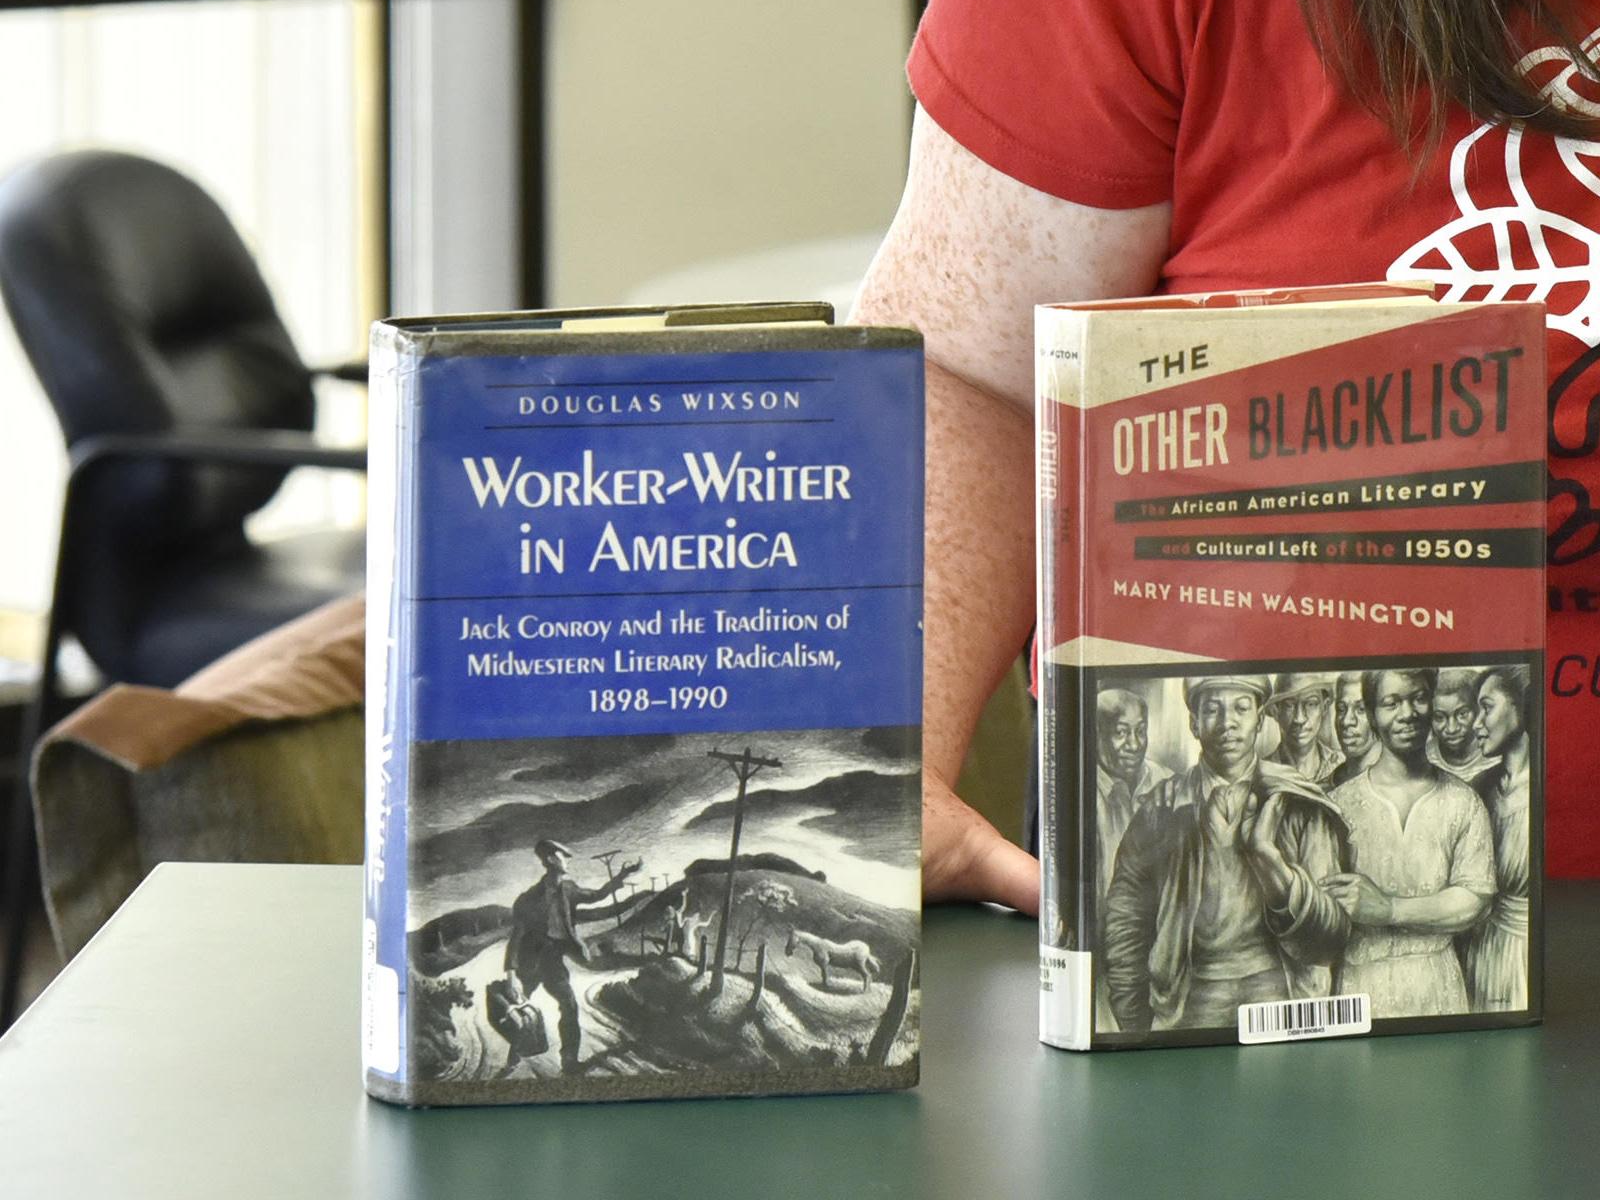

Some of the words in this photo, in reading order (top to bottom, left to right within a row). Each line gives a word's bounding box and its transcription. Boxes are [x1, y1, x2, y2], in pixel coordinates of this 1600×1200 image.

[1140, 344, 1209, 384] THE
[519, 393, 662, 415] DOUGLAS
[683, 391, 800, 411] WIXSON
[1113, 403, 1229, 475] OTHER
[1248, 347, 1524, 461] BLACKLIST
[1141, 503, 1168, 518] The
[1171, 498, 1238, 516] African
[1247, 489, 1349, 512] American
[1360, 479, 1486, 503] Literary
[520, 523, 564, 574] in
[1161, 541, 1190, 555] and
[1196, 539, 1274, 557] Cultural
[1280, 540, 1317, 557] Left
[1326, 540, 1349, 557] of
[1355, 540, 1395, 557] the
[1405, 539, 1491, 559] 1950s
[459, 616, 510, 641] Jack
[517, 613, 610, 642] Conroy
[619, 610, 661, 636] and
[670, 609, 705, 634] the
[714, 607, 817, 633] Tradition
[825, 604, 850, 630] of
[1113, 579, 1171, 600] MARY
[1179, 585, 1252, 609] HELEN
[1262, 593, 1455, 630] WASHINGTON
[467, 649, 604, 677] Midwestern
[614, 648, 706, 675] Literary
[716, 645, 841, 672] Radicalism,
[589, 686, 728, 713] 1898–1990
